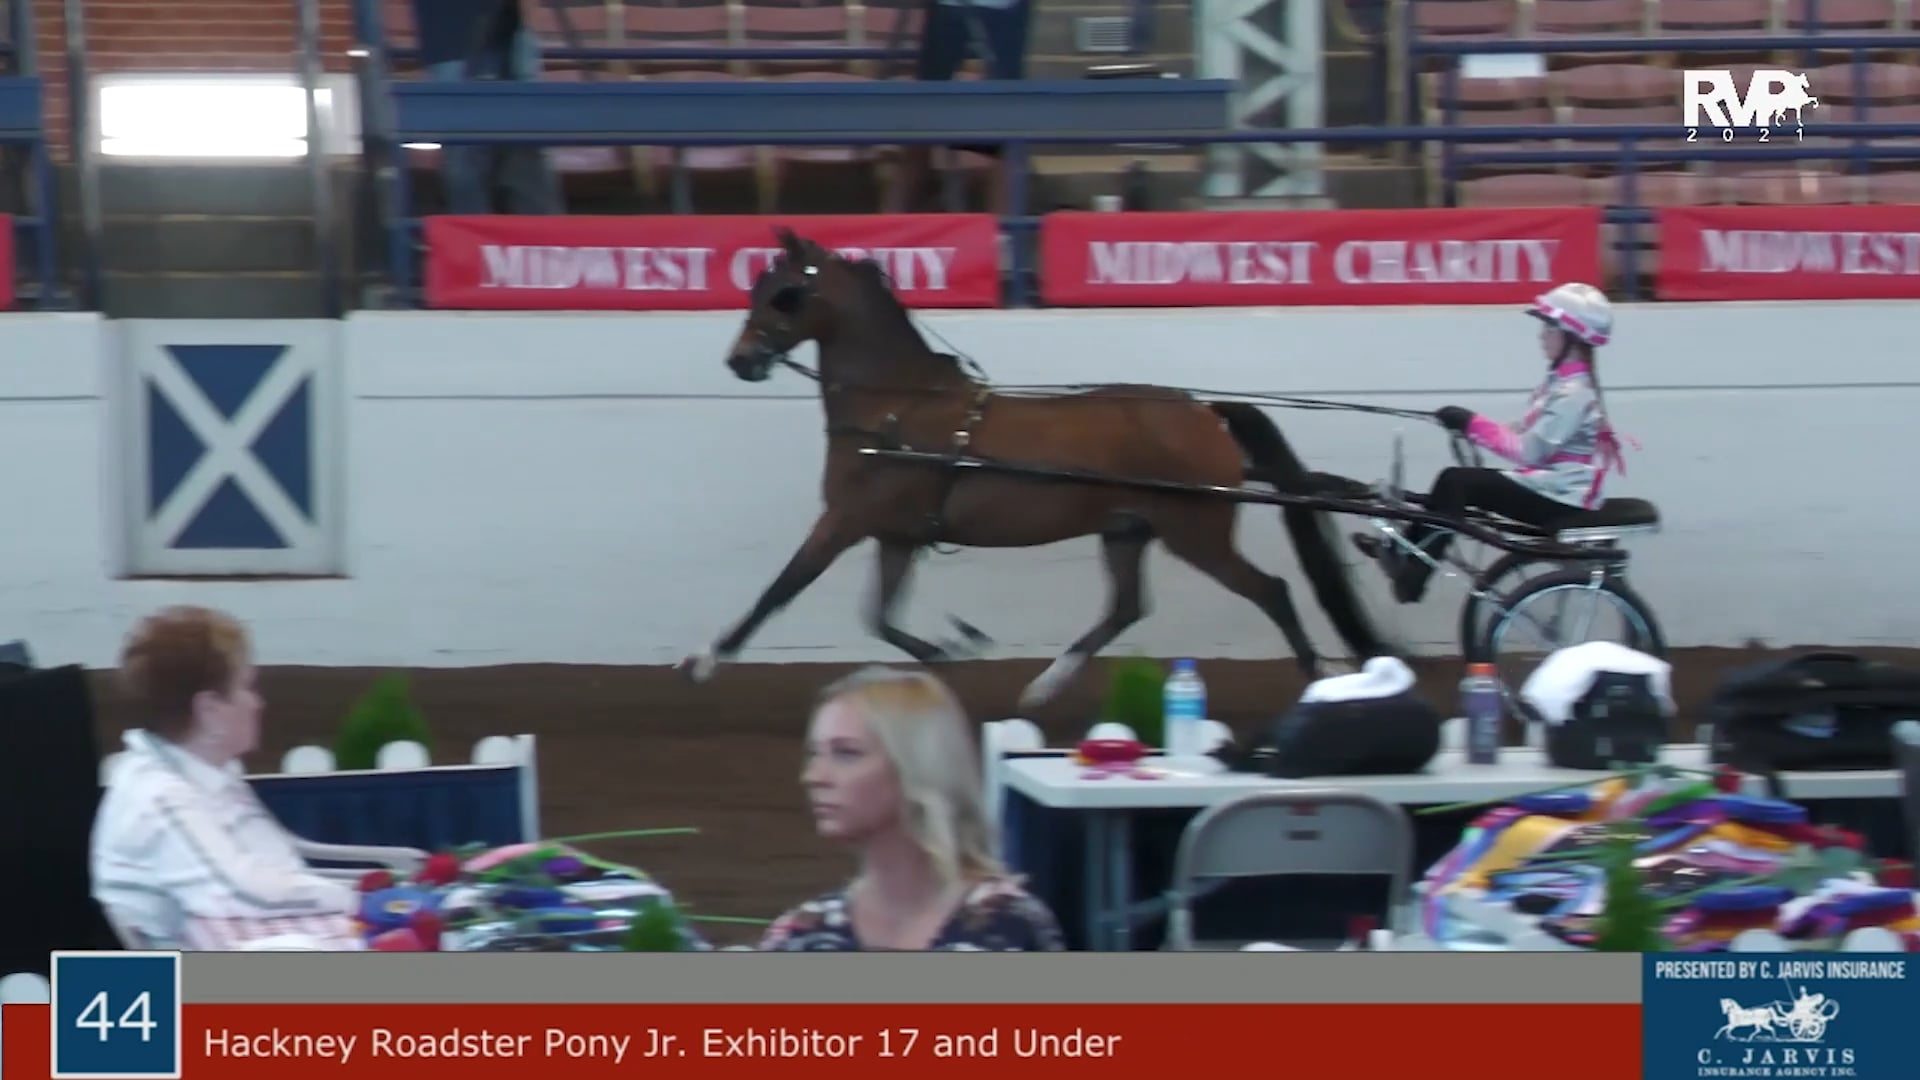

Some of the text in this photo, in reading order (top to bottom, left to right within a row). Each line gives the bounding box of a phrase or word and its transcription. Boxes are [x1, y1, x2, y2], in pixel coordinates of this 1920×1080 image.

[480, 245, 713, 290] MIDWEST
[1088, 239, 1560, 284] MIDWEST CHARITY
